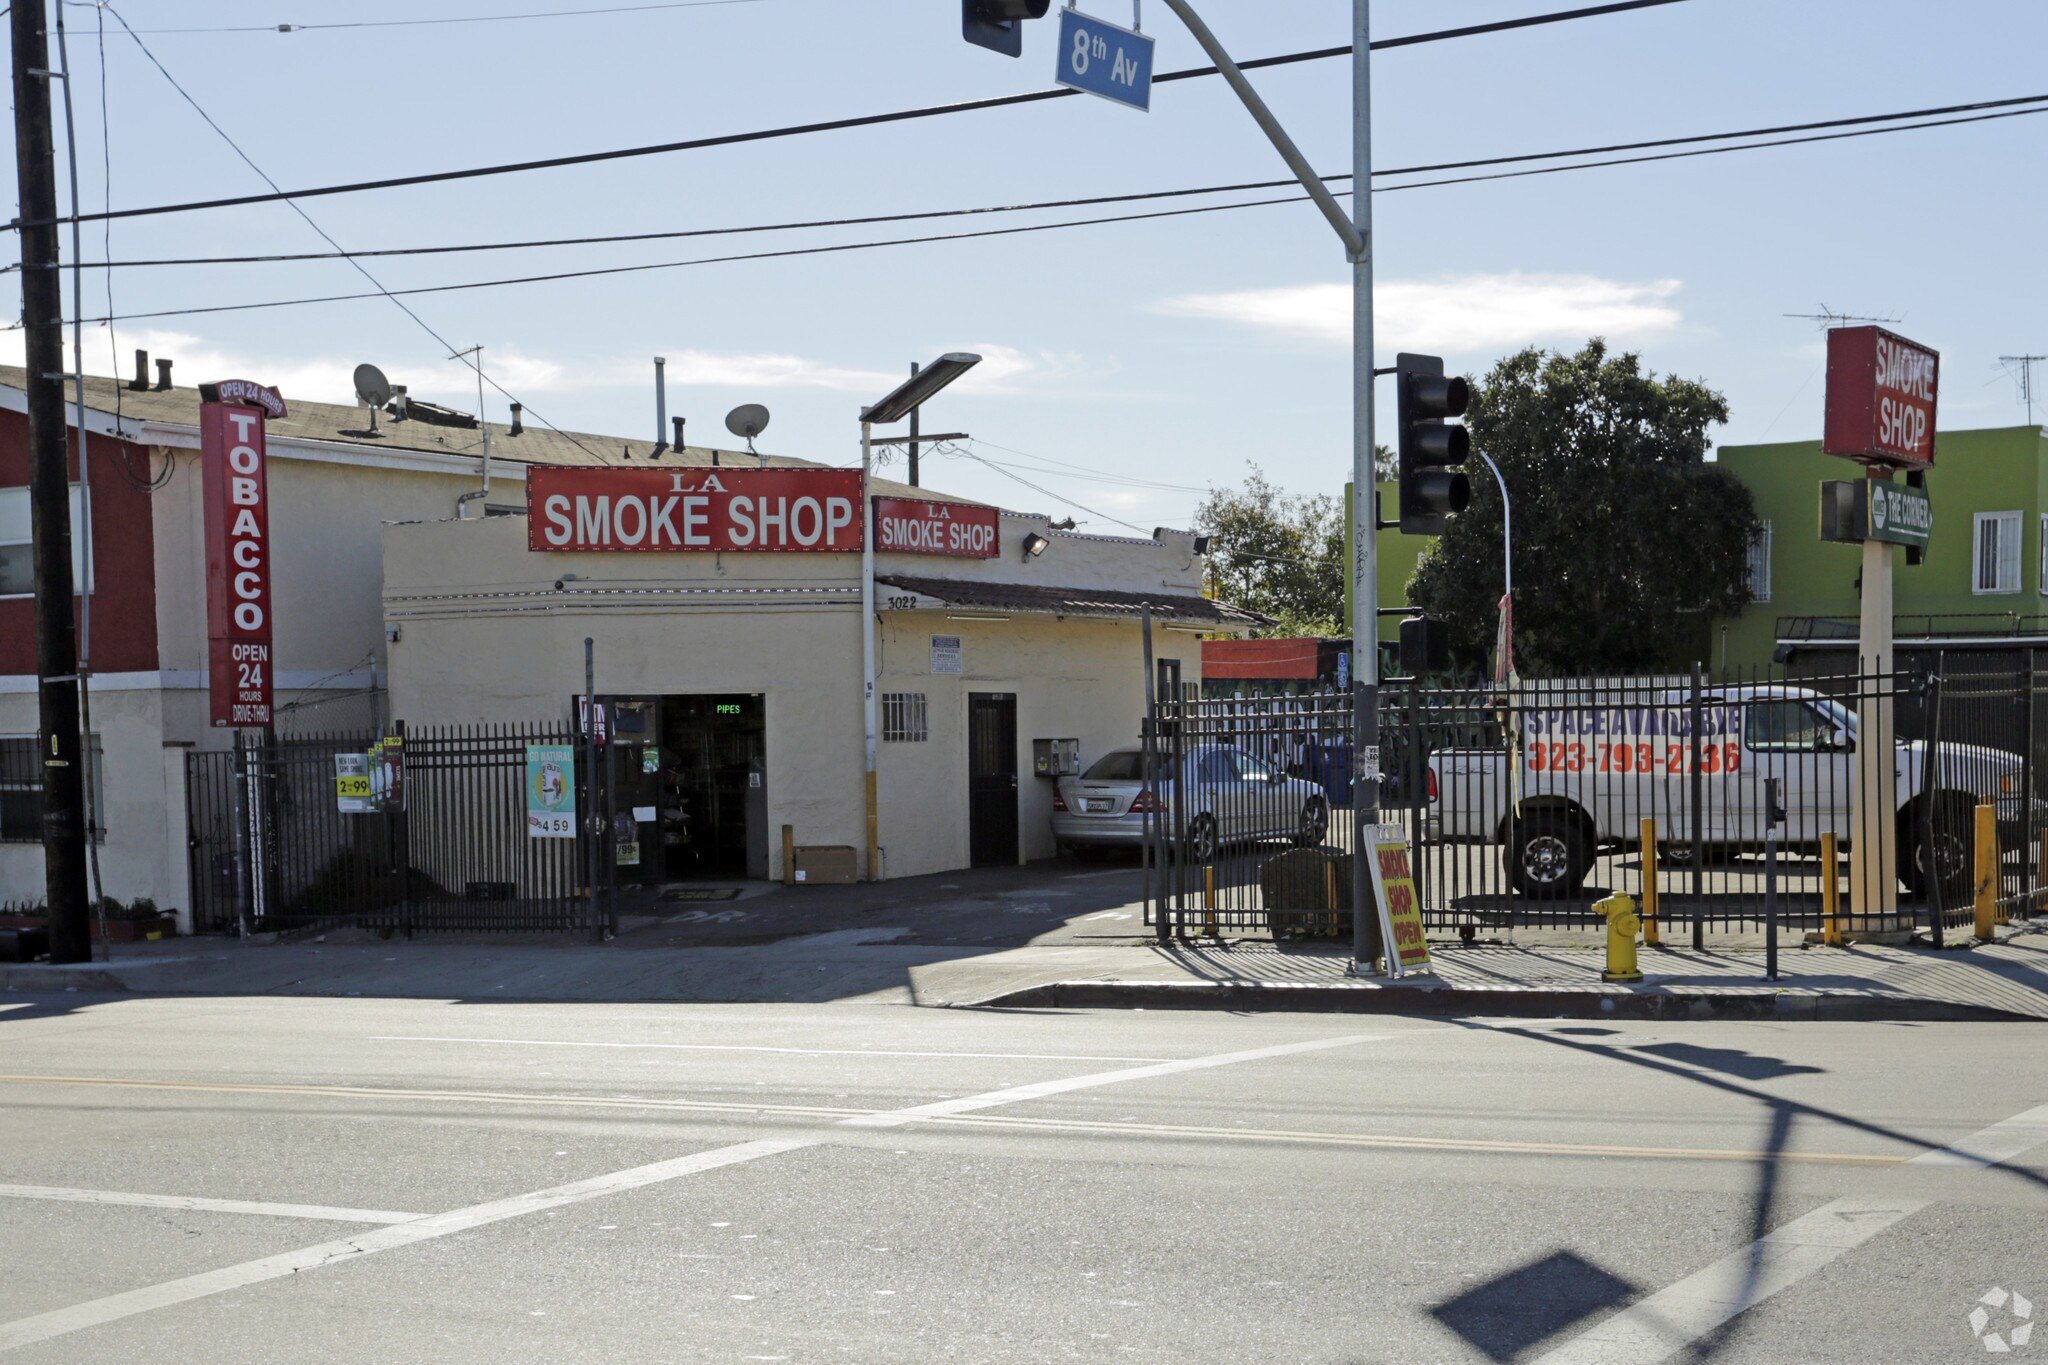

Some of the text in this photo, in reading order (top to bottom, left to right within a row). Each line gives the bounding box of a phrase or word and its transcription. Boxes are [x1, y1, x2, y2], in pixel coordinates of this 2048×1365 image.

[1071, 28, 1138, 87] 8th Av
[1876, 337, 1935, 402] SMOKE
[220, 382, 284, 413] OPEN 24 HOURS
[1880, 397, 1926, 452] SHOP
[669, 473, 728, 493] LA
[229, 413, 263, 631] TOBACCO
[544, 494, 852, 546] SMOKE SHOP
[928, 504, 951, 519] LA
[1887, 491, 1929, 529] THE CORNER
[882, 517, 994, 551] SMOKE SHOP
[888, 596, 917, 610] 3022
[232, 643, 268, 662] OPEN
[238, 663, 263, 689] 24
[239, 691, 262, 702] HOURS
[716, 704, 742, 714] PIPES
[1528, 707, 1606, 735] SPACE
[540, 751, 571, 762] NATURAL
[339, 781, 347, 793] 2
[1377, 849, 1410, 880] SMOKE
[1387, 885, 1412, 916] SHOP
[1393, 921, 1422, 946] OPEN
